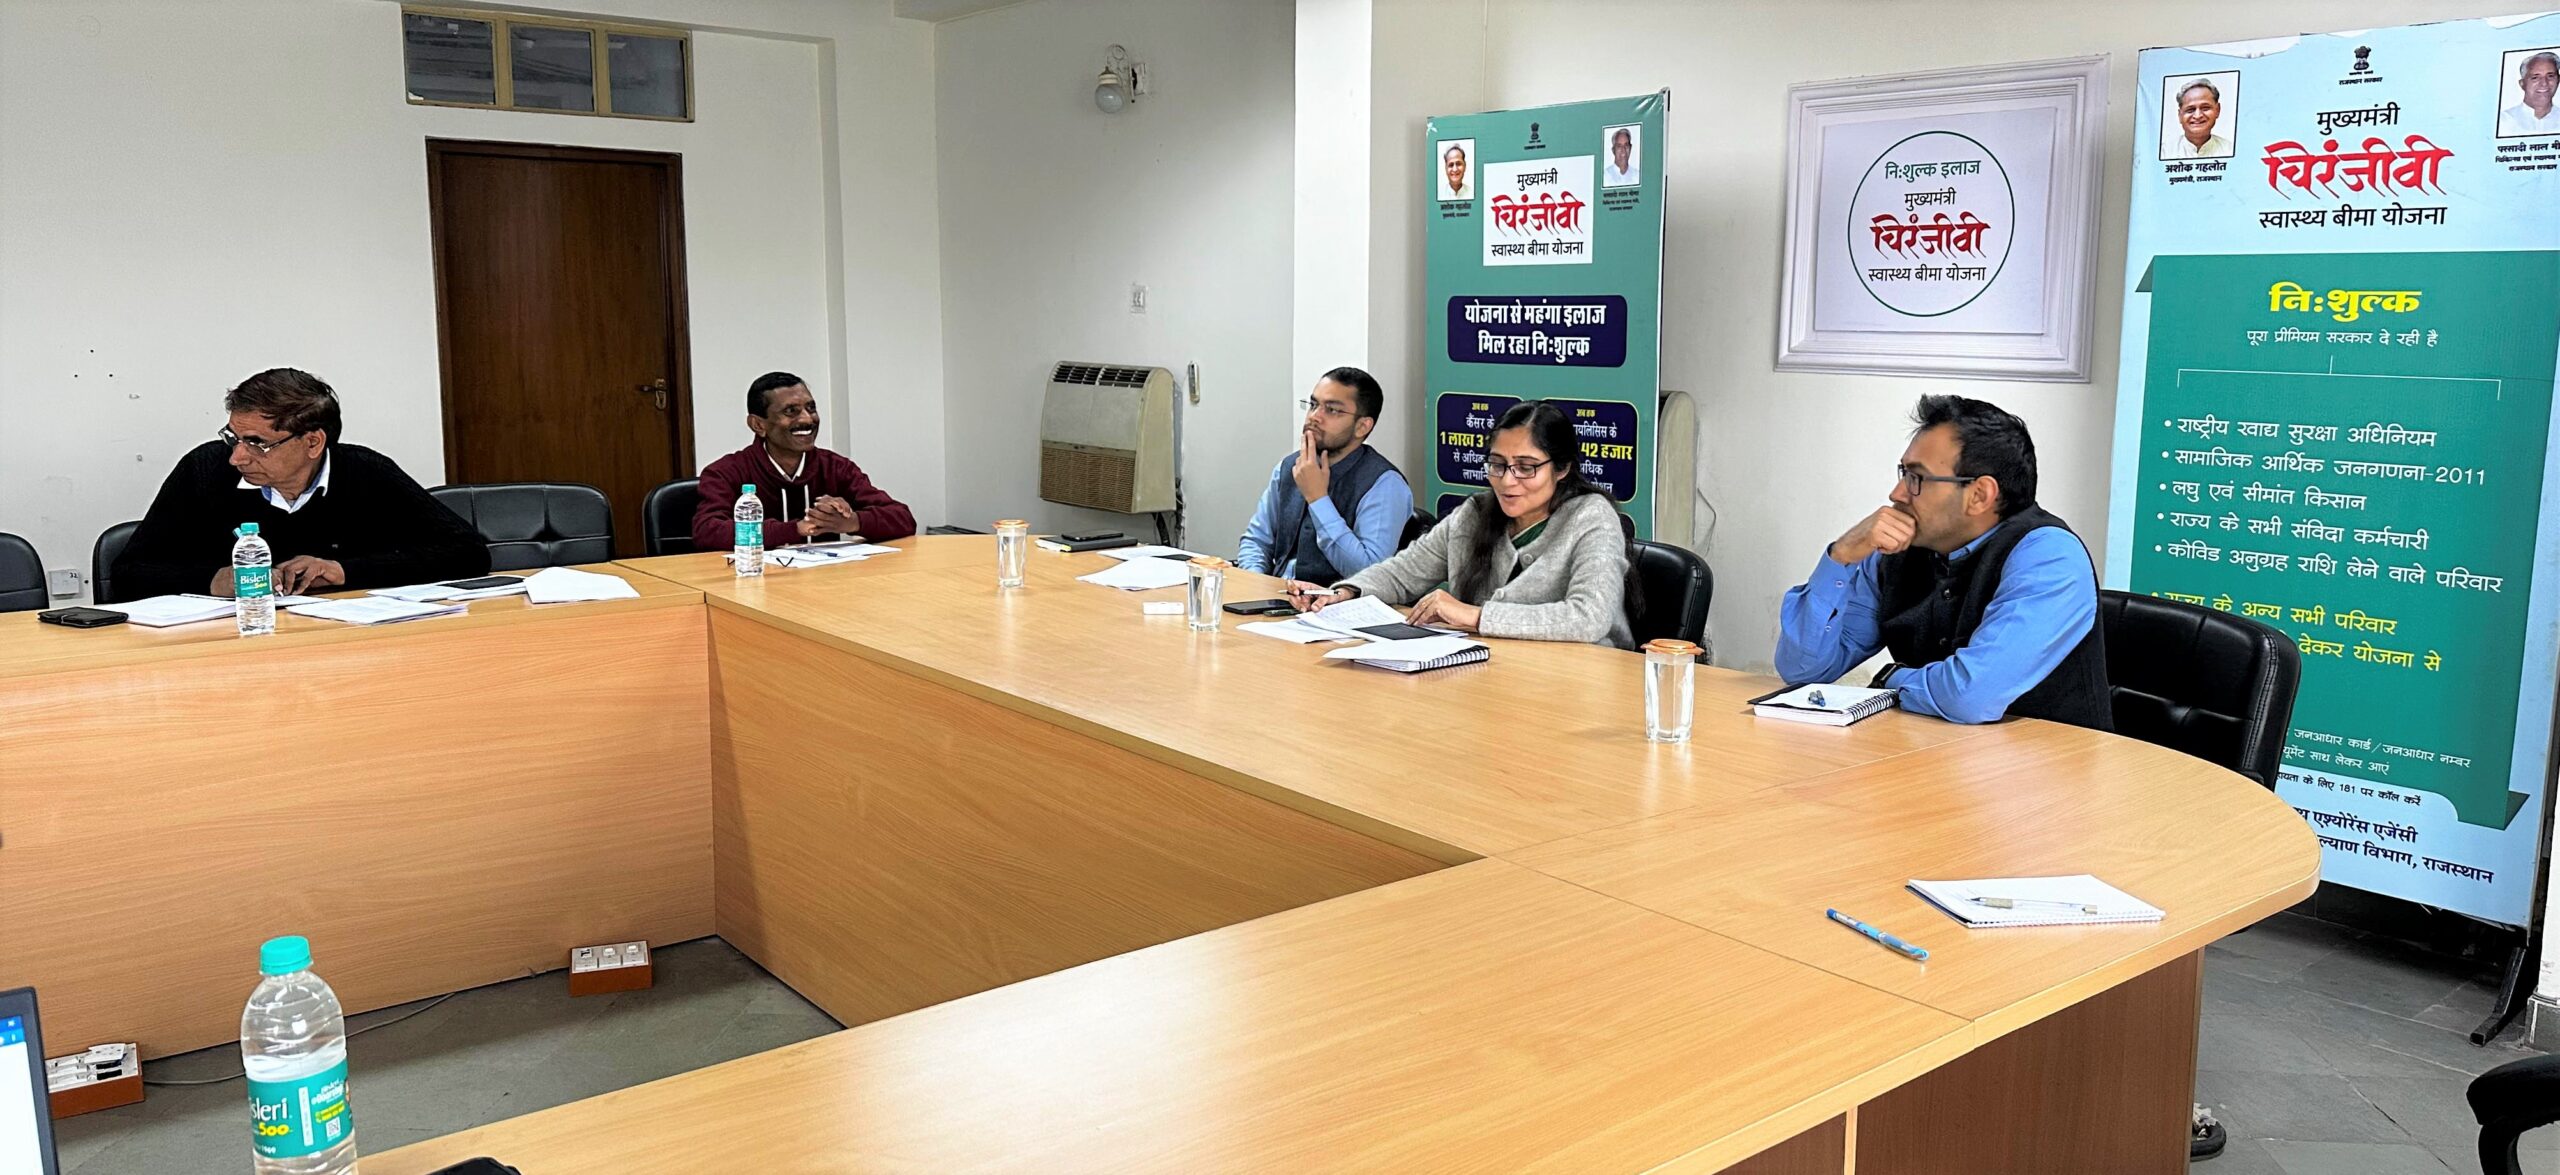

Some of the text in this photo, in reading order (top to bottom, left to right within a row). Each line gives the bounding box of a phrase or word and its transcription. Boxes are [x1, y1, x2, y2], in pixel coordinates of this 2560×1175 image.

[2316, 101, 2401, 135] मुख्यमंत्री
[1516, 168, 1558, 191] मुख्यमंत्री
[1941, 160, 1982, 178] इलाज
[2165, 160, 2228, 173] अशोक गहलोत
[2261, 134, 2455, 200] चिरंजीवी
[1491, 191, 1586, 236] चिरंजीवी
[1904, 186, 1956, 211] मुख्यमंत्री
[2258, 202, 2447, 230] स्वास्थ्य बीमा योजना
[1491, 239, 1584, 258] स्वास्थ्य बीमा योजना
[1870, 211, 1991, 260] चिरंजीवी
[1868, 263, 1986, 282] स्वास्थ्य बीमा योजना
[1464, 298, 1606, 328] योजना से महंगा इलाज
[1478, 330, 1505, 354] मिल
[1508, 336, 1530, 355] रहा
[2247, 327, 2438, 347] पूरा प्रीमियम सरकार दे रही है
[1486, 414, 1496, 430] के
[1572, 420, 1618, 438] ायलिसिस के
[2177, 414, 2437, 447] राष्ट्रीय खाद्य सुरक्षा अधिनियम
[1440, 431, 1446, 445] 1
[1448, 432, 1475, 448] लाख
[1581, 442, 1634, 460] 42 हजार
[1453, 448, 1486, 464] से अधिक
[2175, 446, 2485, 486] सामाजिक आर्थिक जनगणना-2011
[2172, 480, 2367, 511] लघु एवं सीमांत किसान
[2170, 512, 2429, 550] राज्य के सभी संविदा कर्मचारी
[240, 572, 267, 584] Bisleri
[2168, 538, 2503, 593] कोविड अनुग्रह राशि लेने वाले परिवार
[2213, 594, 2233, 612] के
[2241, 602, 2282, 620] अन्य
[2290, 605, 2325, 626] सभी
[2334, 610, 2398, 636] परिवार
[2298, 632, 2442, 672] देकर योजना से
[2283, 744, 2390, 776] यूमेंट साथ लेकर आएं
[2294, 728, 2344, 746] जनआधार
[2440, 754, 2472, 768] नम्बर
[2277, 772, 2422, 806] ायता के लिए 181 पर कॉल करें
[2314, 811, 2370, 834] एश्योरेंस
[2374, 821, 2418, 844] एजेंसी
[2317, 834, 2494, 884] ल्याण विभाग, राजस्थान
[248, 1097, 288, 1122] sleri
